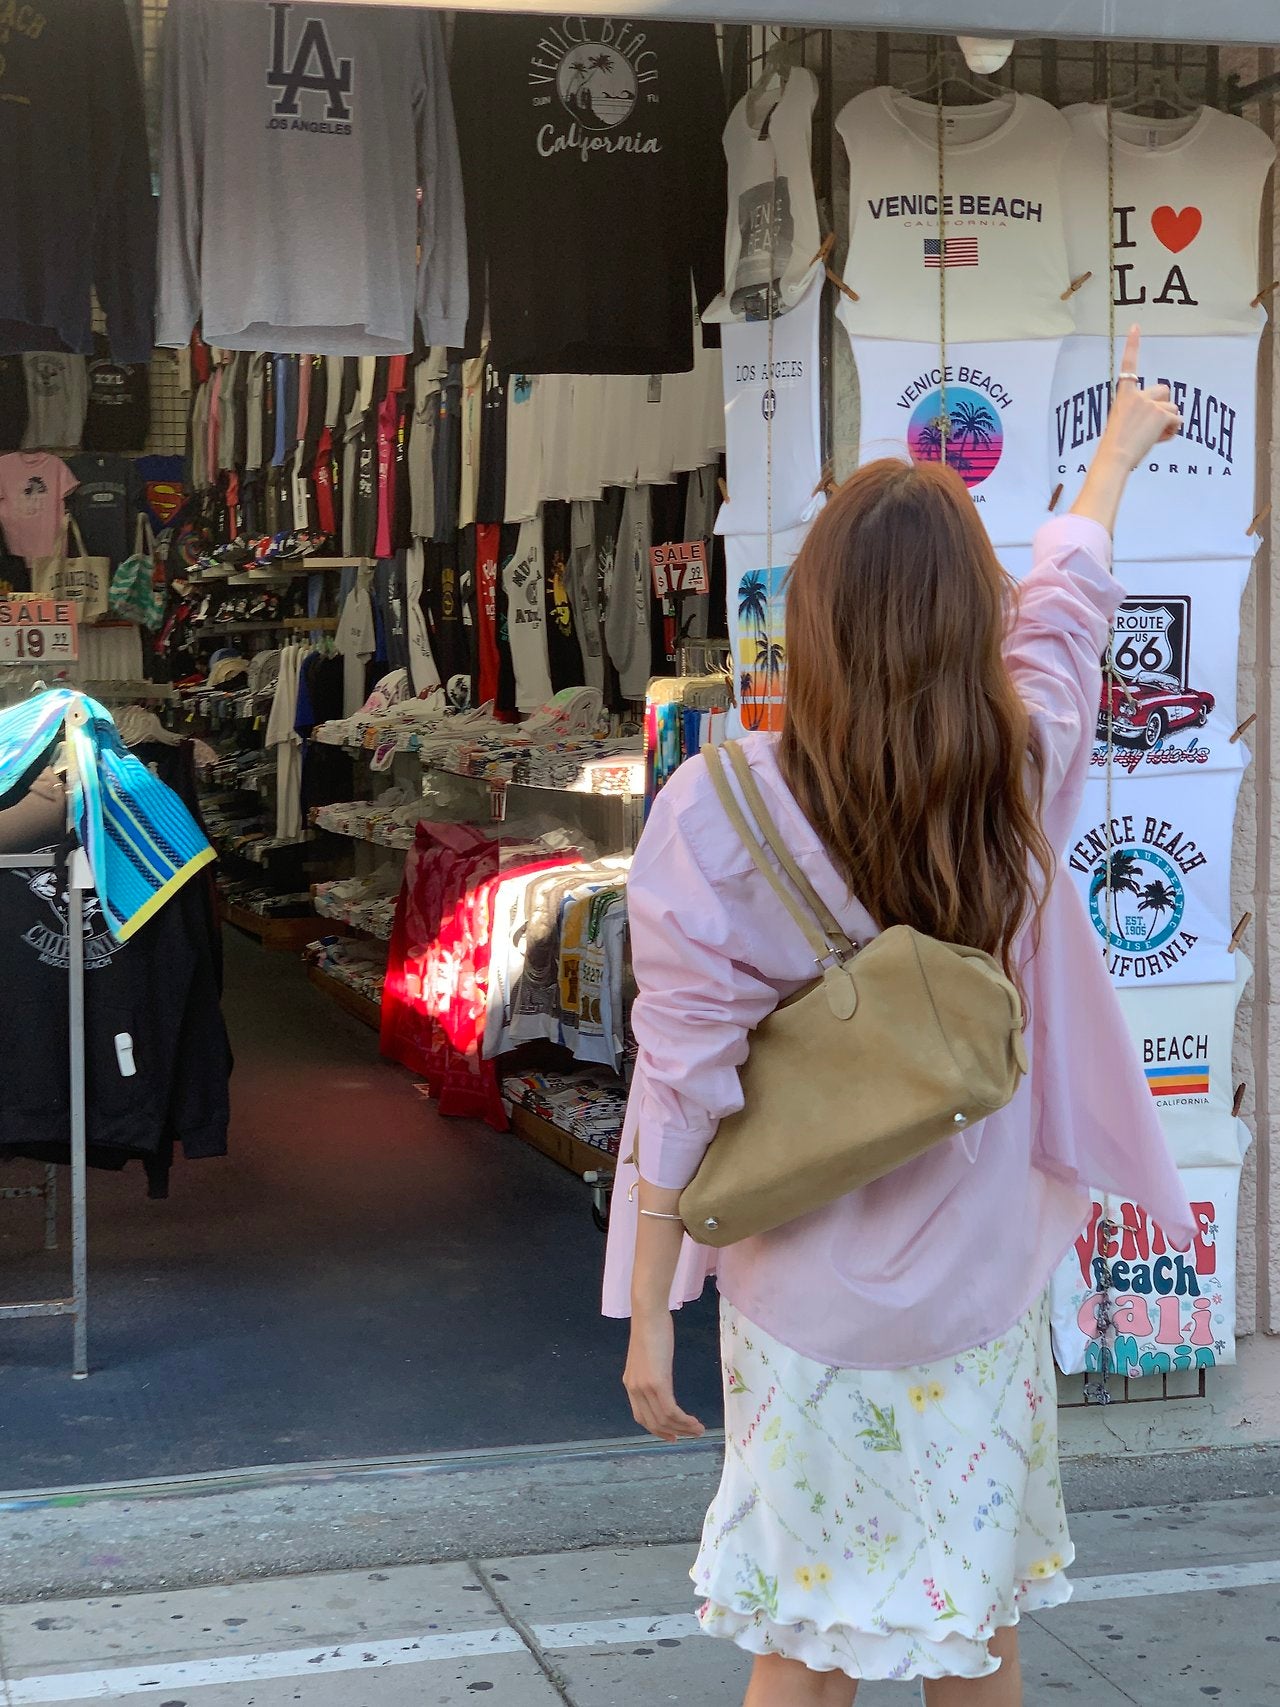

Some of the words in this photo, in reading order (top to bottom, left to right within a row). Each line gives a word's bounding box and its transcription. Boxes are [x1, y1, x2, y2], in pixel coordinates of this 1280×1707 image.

[265, 2, 354, 122] LA
[528, 16, 591, 85] VENICE
[600, 17, 659, 83] BEACH
[291, 120, 352, 135] ANGELES
[867, 195, 953, 219] VENICE
[959, 195, 1042, 223] BEACH
[1112, 206, 1136, 248] I
[1113, 263, 1198, 306] LA
[736, 365, 756, 382] LOS
[897, 366, 954, 411] VENICE
[958, 366, 1013, 409] BEACH
[1157, 378, 1236, 464] EACH
[1058, 463, 1232, 476] CAORNIA
[655, 544, 701, 563] SALE
[0, 604, 70, 623] SALE
[1116, 616, 1164, 629] ROUTE
[1135, 633, 1148, 643] US
[1115, 636, 1163, 671] 66
[1069, 815, 1135, 874] VENICE
[1142, 816, 1207, 875] BEACH
[1132, 850, 1184, 929] AUTHENTIC
[1090, 901, 1152, 950] PARDISE
[1125, 916, 1146, 927] EST.
[1125, 926, 1147, 936] 1905
[1103, 930, 1199, 978] IFORNIA
[1144, 1035, 1208, 1063] BEACH
[1156, 1097, 1210, 1108] CALIFORNIA
